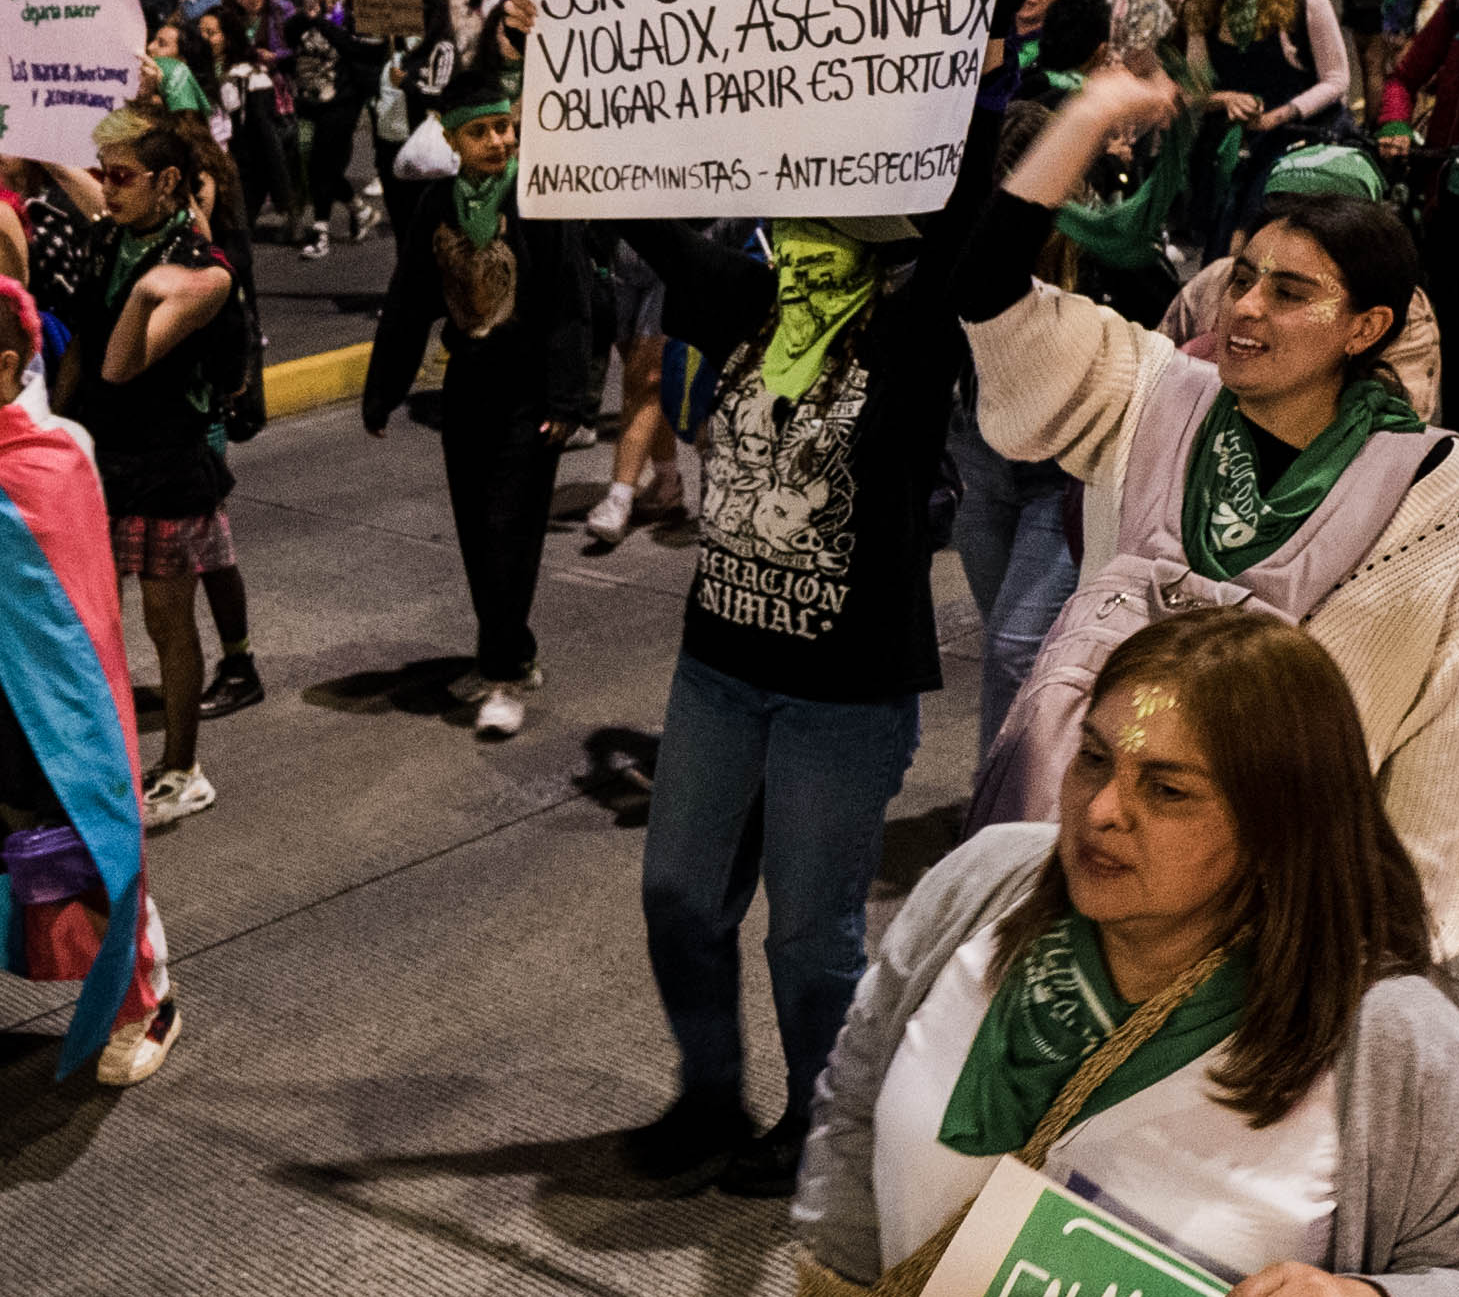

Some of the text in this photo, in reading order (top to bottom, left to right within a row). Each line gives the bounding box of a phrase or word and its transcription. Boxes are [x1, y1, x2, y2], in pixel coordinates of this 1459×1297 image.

[536, 6, 730, 84] VIOLADX,
[537, 48, 979, 134] OBLIGAR A PARIR ES TORTURA
[526, 158, 752, 198] ANARCOFEMINISTAS
[698, 578, 818, 640] NIMAL
